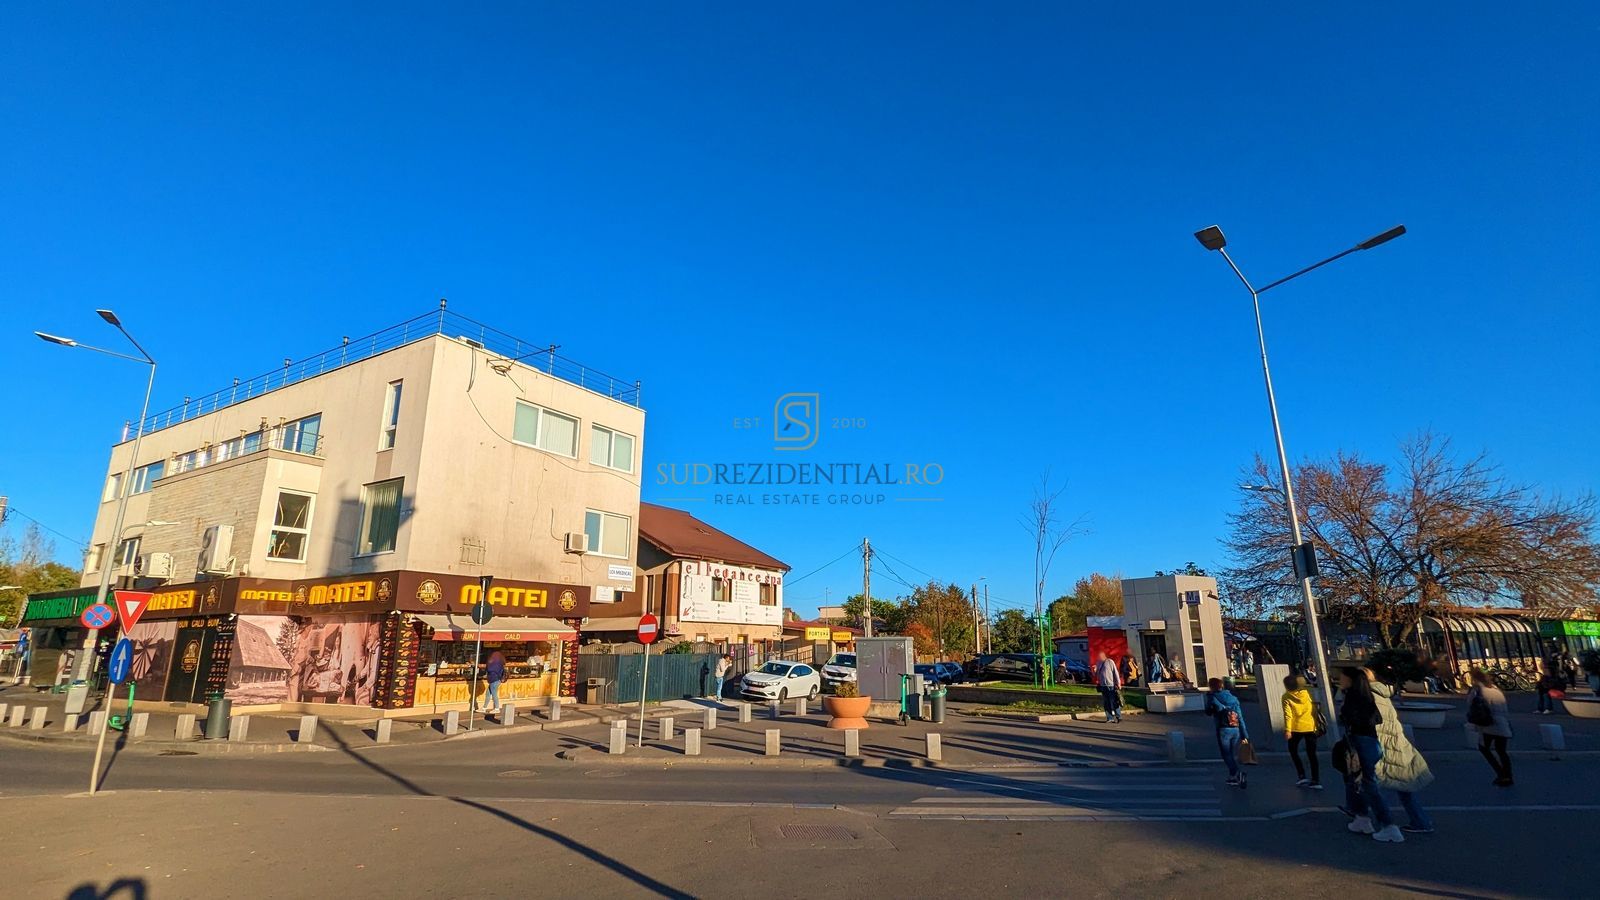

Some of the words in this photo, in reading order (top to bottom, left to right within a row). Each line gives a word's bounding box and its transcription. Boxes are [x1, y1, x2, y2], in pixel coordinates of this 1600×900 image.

[240, 589, 292, 602] MATEI
[308, 581, 374, 605] MATEI
[461, 584, 547, 608] MATEI
[191, 619, 205, 628] CALD
